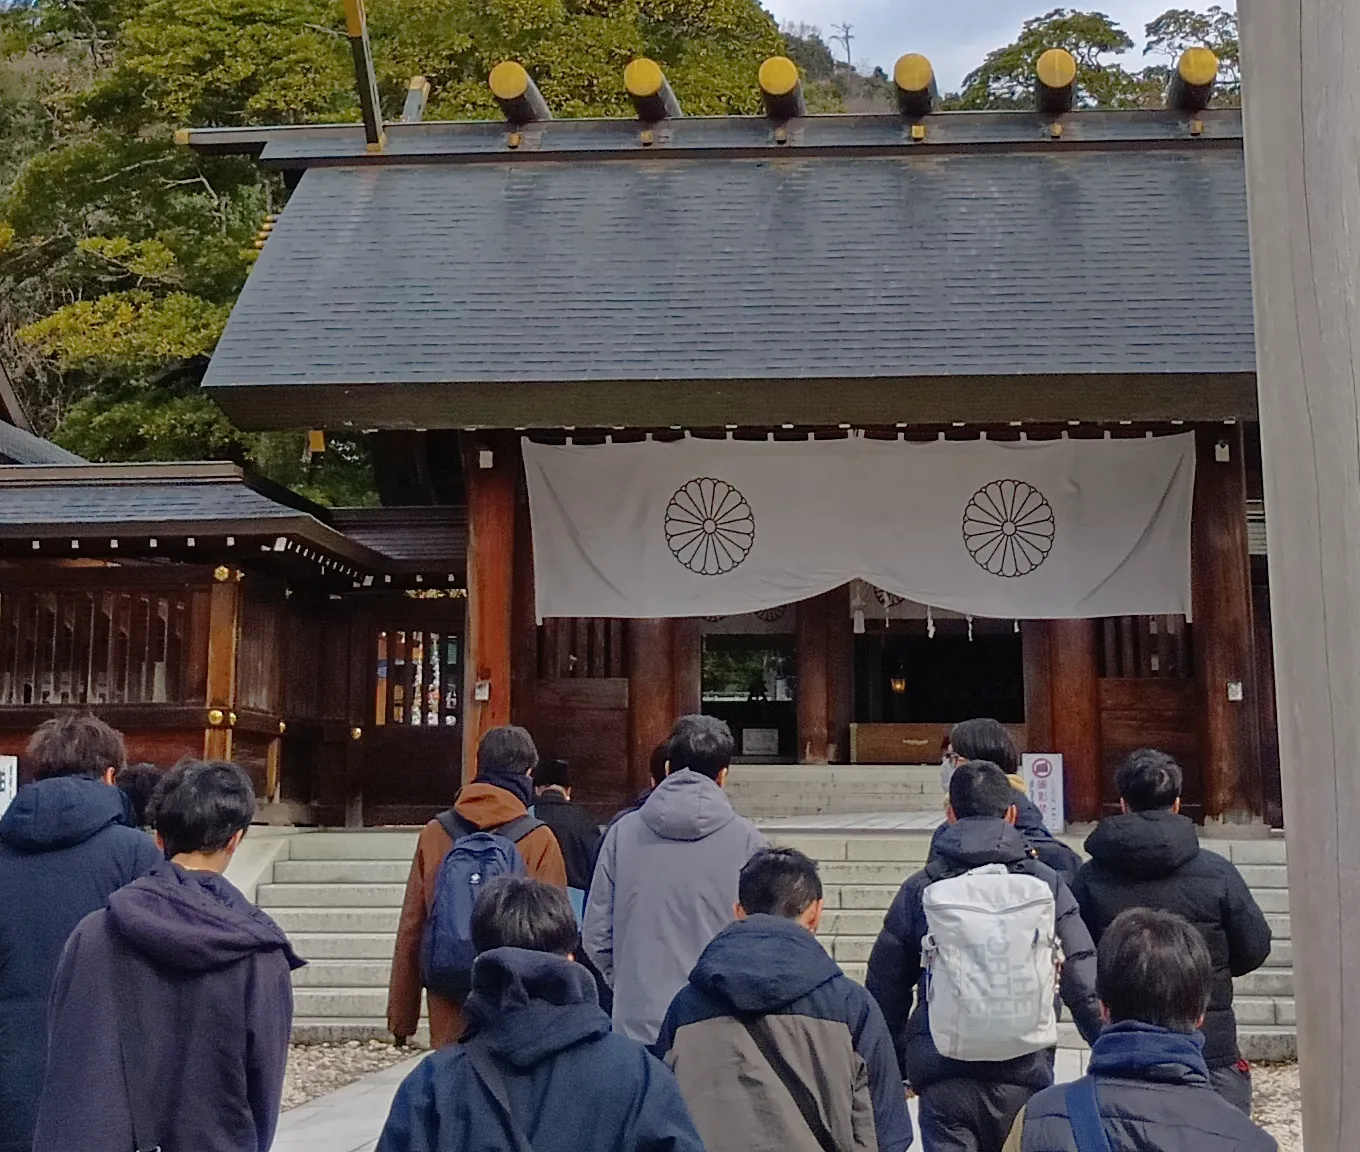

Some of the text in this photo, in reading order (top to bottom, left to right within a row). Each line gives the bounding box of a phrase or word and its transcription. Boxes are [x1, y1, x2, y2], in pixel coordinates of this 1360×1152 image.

[1037, 778, 1049, 825] 撮影禁
[986, 918, 1011, 1015] ORTH
